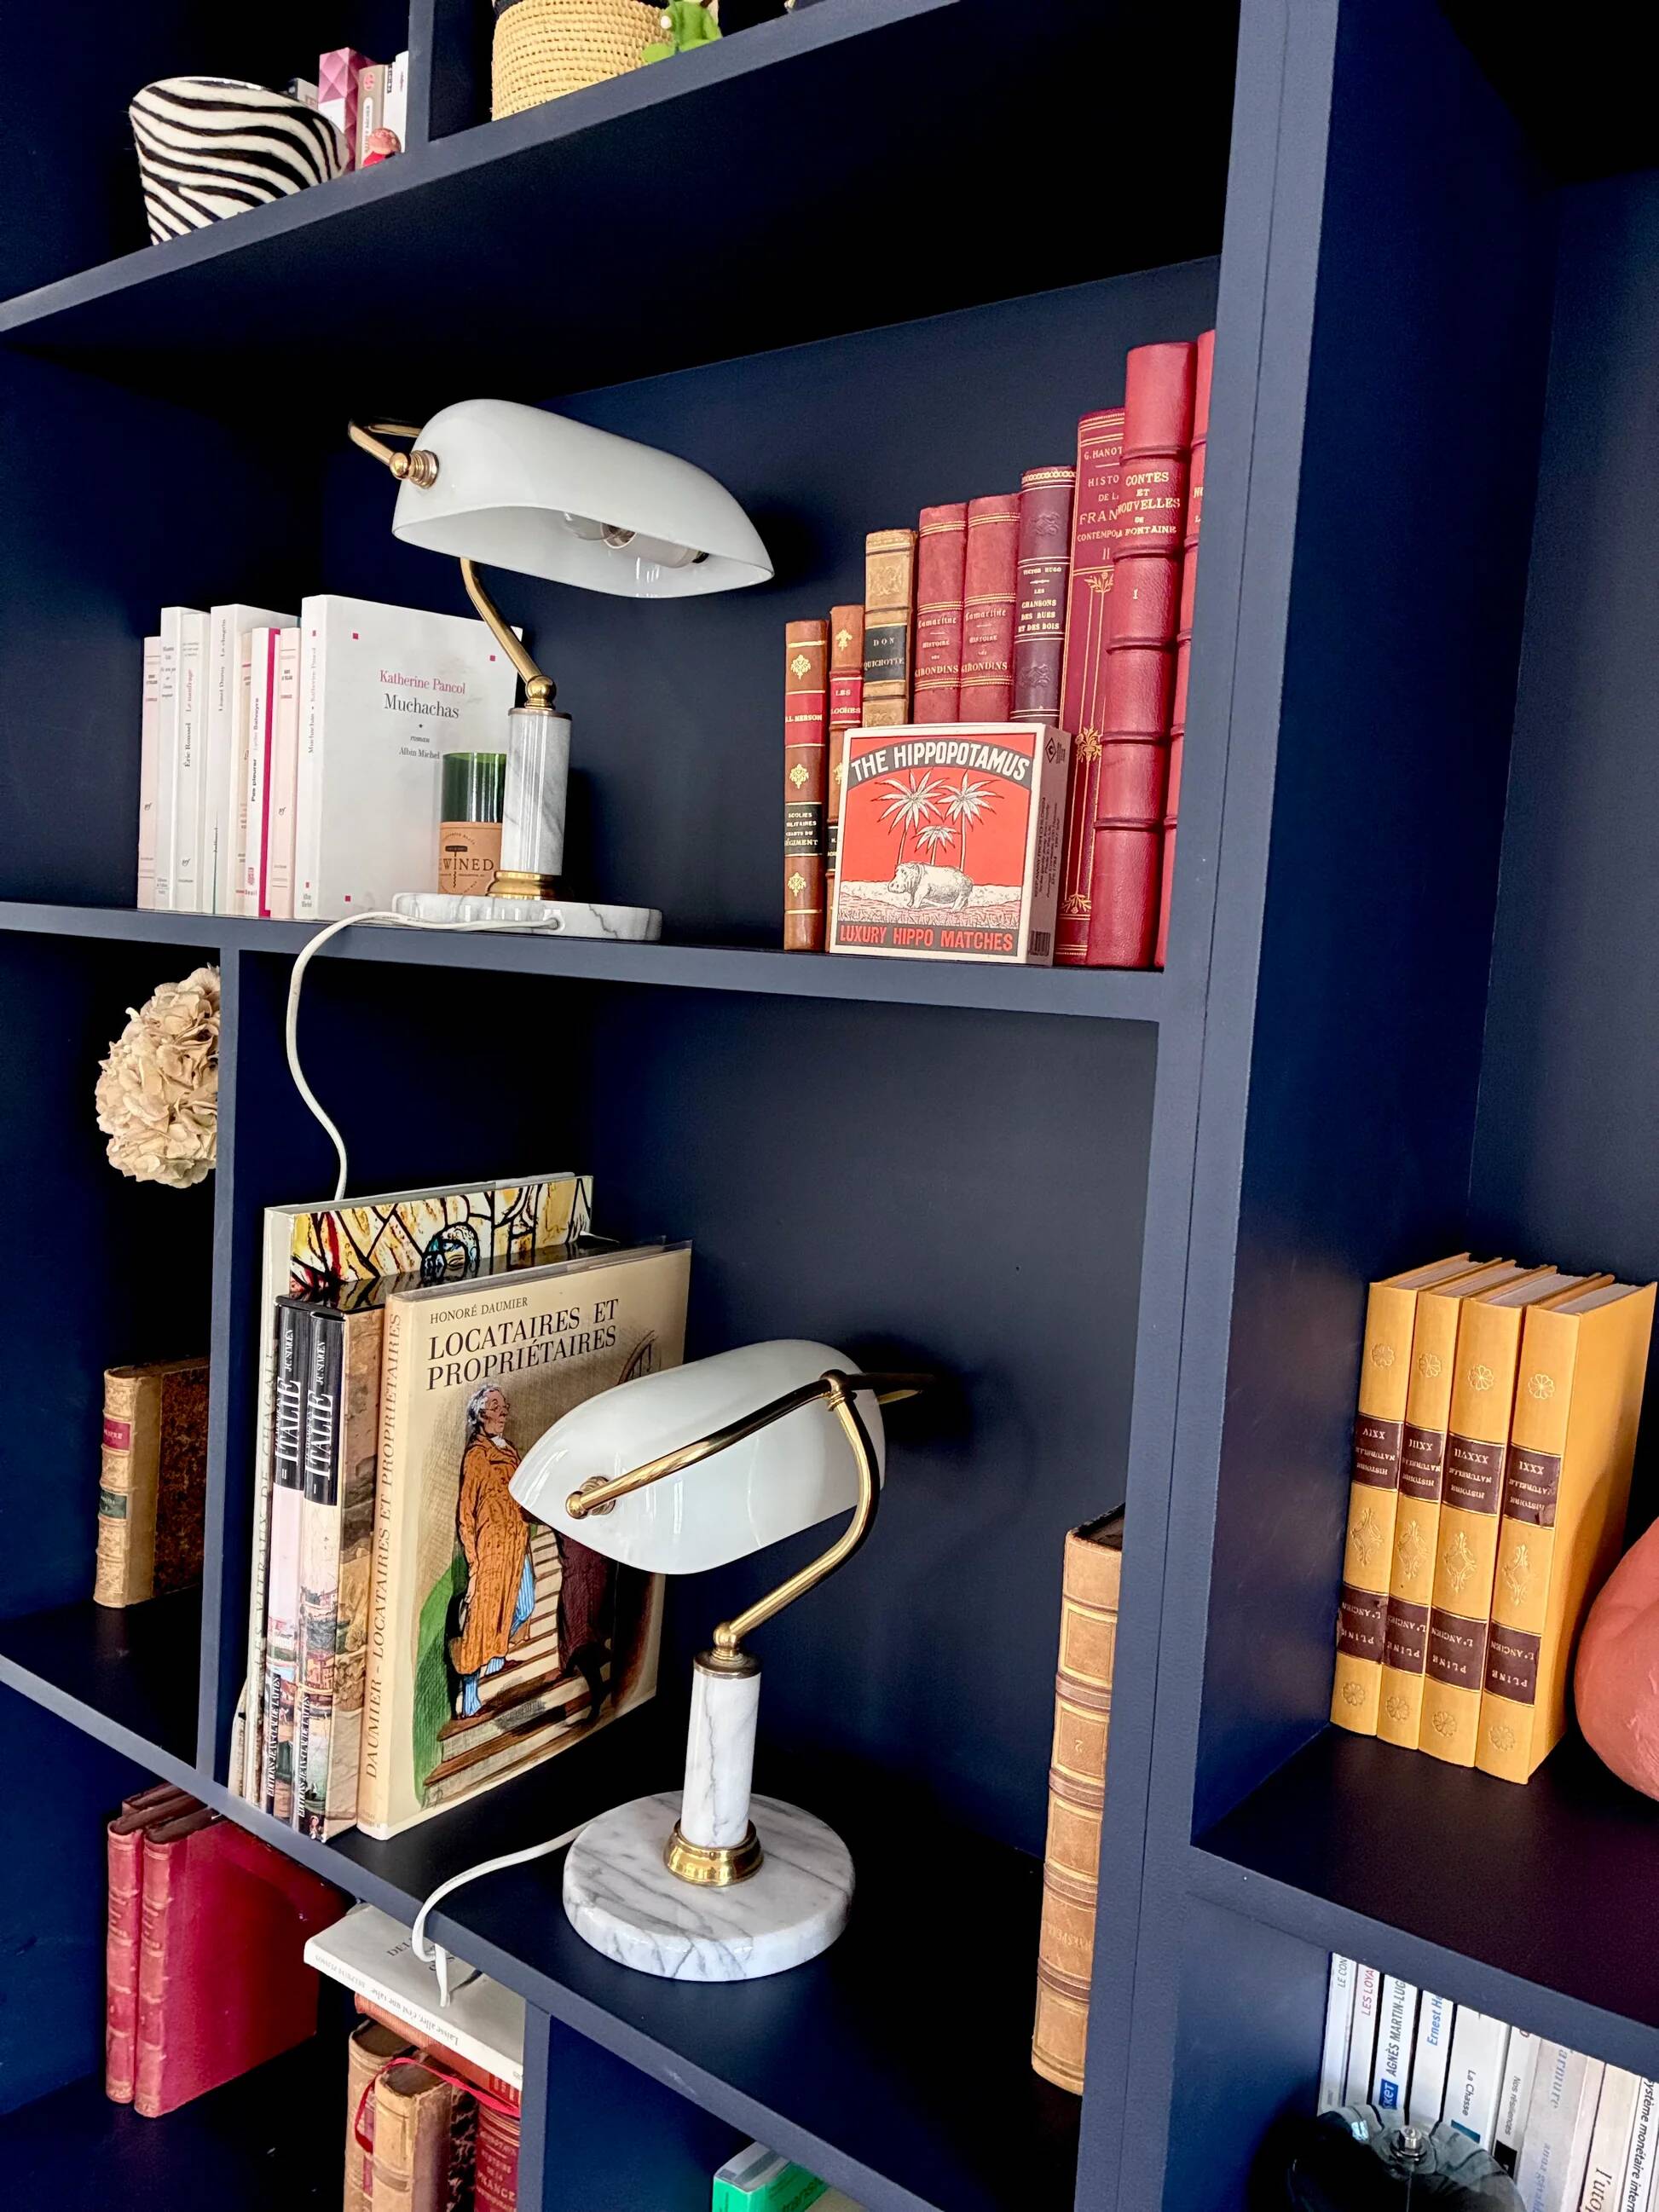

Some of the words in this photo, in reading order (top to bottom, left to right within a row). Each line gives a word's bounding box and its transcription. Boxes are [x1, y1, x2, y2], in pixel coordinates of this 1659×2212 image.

[1125, 471, 1170, 487] CONTES
[1099, 493, 1109, 502] DE
[1136, 488, 1150, 497] ET
[1117, 497, 1181, 516] NOUVELLES
[1124, 525, 1177, 536] FONTAINE
[1021, 599, 1057, 609] CHANSONS
[1020, 612, 1033, 621] DES
[873, 637, 895, 647] DON
[380, 670, 430, 690] Katherine
[432, 678, 466, 695] Pancol
[384, 693, 460, 719] Muchachas
[399, 747, 417, 757] Albin
[418, 748, 440, 759] Michel
[851, 749, 889, 783] THE
[893, 741, 1031, 782] HIPPOPOTAMUS
[784, 838, 818, 846] ÉGIMENT
[840, 925, 887, 944] LUXURY
[893, 927, 934, 947] HIPPO
[940, 930, 1014, 952] MATCHES
[431, 1303, 477, 1324] HONORÉ
[480, 1297, 529, 1315] DAUMIER
[428, 1307, 581, 1360] LOCATAIRES
[593, 1298, 619, 1325] ET
[426, 1325, 616, 1391] PROPRIÉTAIRES
[380, 1314, 402, 1487] PROPRIÉTAIRES
[275, 1377, 301, 1466] ITALIE
[305, 1389, 332, 1481] ITALIE
[1362, 1427, 1386, 1440] XXIV
[1408, 1438, 1433, 1451] XXIII
[1454, 1447, 1489, 1464] XXXVII
[1357, 1462, 1388, 1476] HISTOIRE
[1448, 1467, 1492, 1484] NATURELLE
[1518, 1460, 1545, 1476] XXXI
[1451, 1484, 1485, 1499] HISTOIRE
[380, 1494, 392, 1521] ET
[373, 1528, 390, 1661] LOCATAIRES
[1387, 1641, 1420, 1658] PLINE
[1432, 1655, 1466, 1674] PLINE
[1491, 1669, 1529, 1688] PLINE
[366, 1679, 382, 1781] DAUMIER
[1337, 1978, 1346, 1989] LE
[1361, 1995, 1373, 2017] LES
[436, 2027, 459, 2046] Laisse
[1427, 2010, 1442, 2047] Ernest
[1384, 2042, 1400, 2077] AGNÈS
[1467, 2069, 1477, 2082] La
[1512, 2076, 1522, 2094] Nos
[1462, 2082, 1475, 2117] Chasse
[1633, 2123, 1649, 2180] monétaire
[477, 2172, 517, 2201] FRANCE
